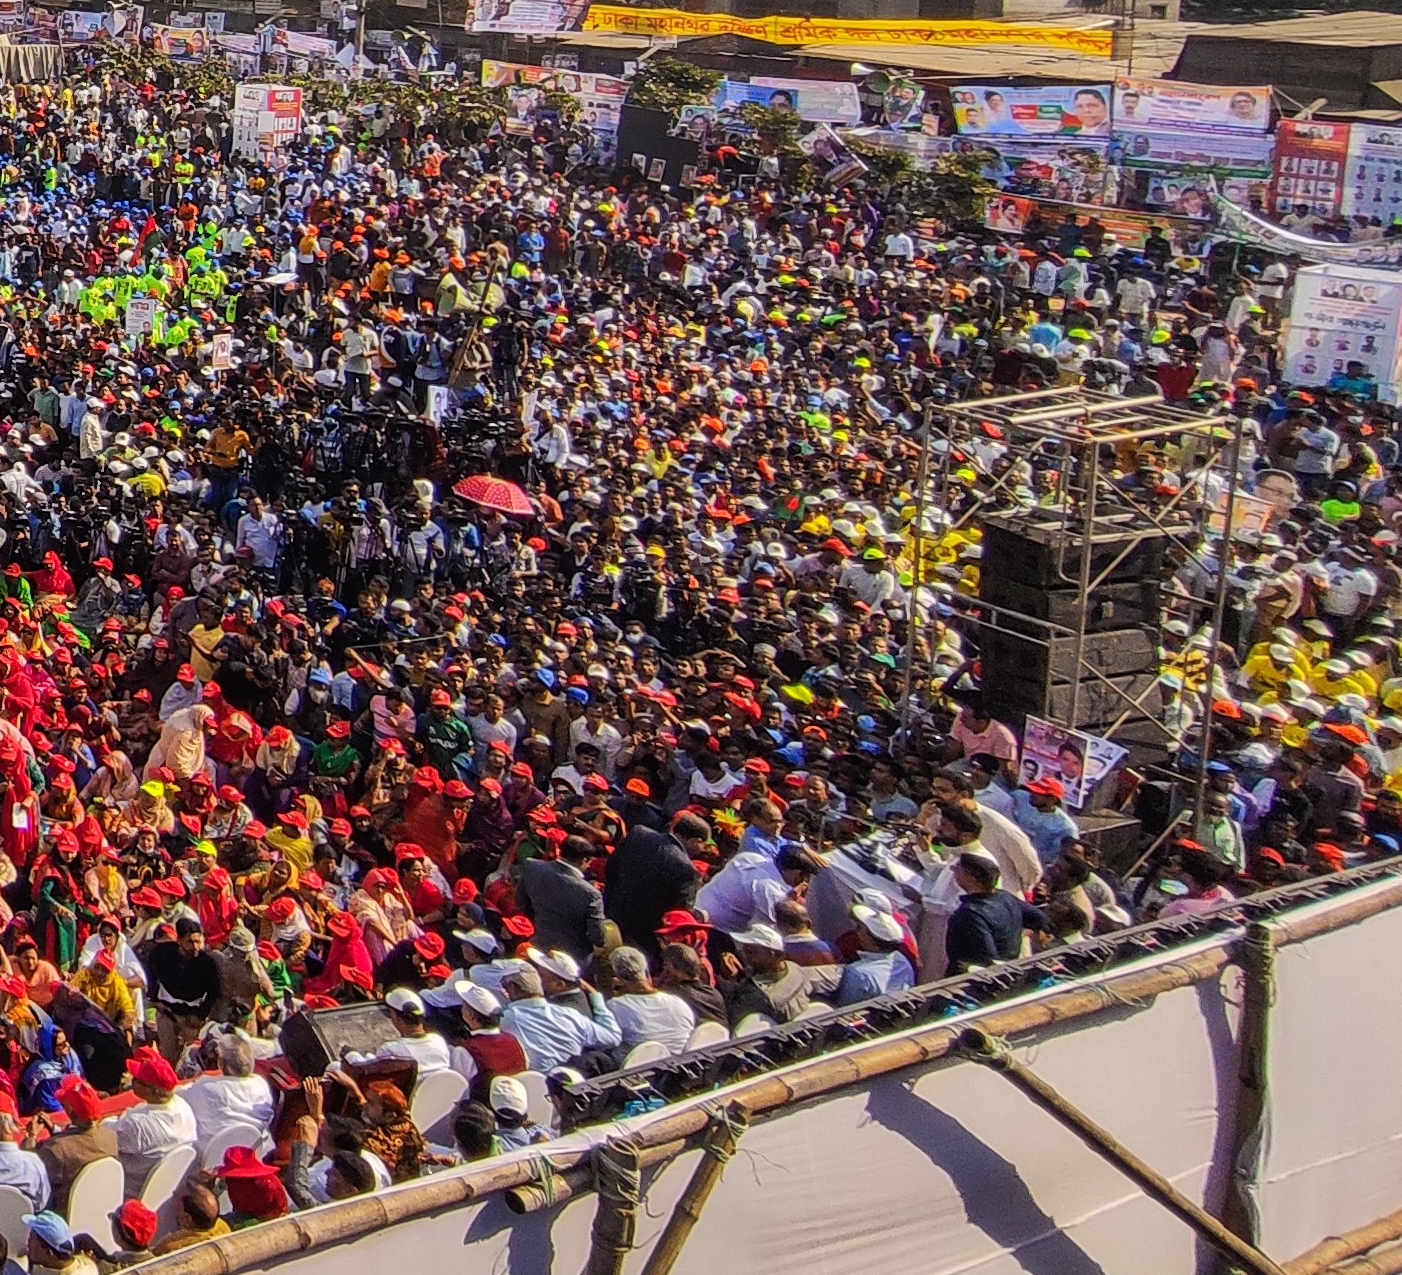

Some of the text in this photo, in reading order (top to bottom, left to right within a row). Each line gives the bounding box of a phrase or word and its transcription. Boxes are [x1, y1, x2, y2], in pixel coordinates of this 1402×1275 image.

[602, 13, 638, 31] ঢাকা
[646, 16, 709, 34] মহানগর
[779, 18, 837, 42] শ্রমিক
